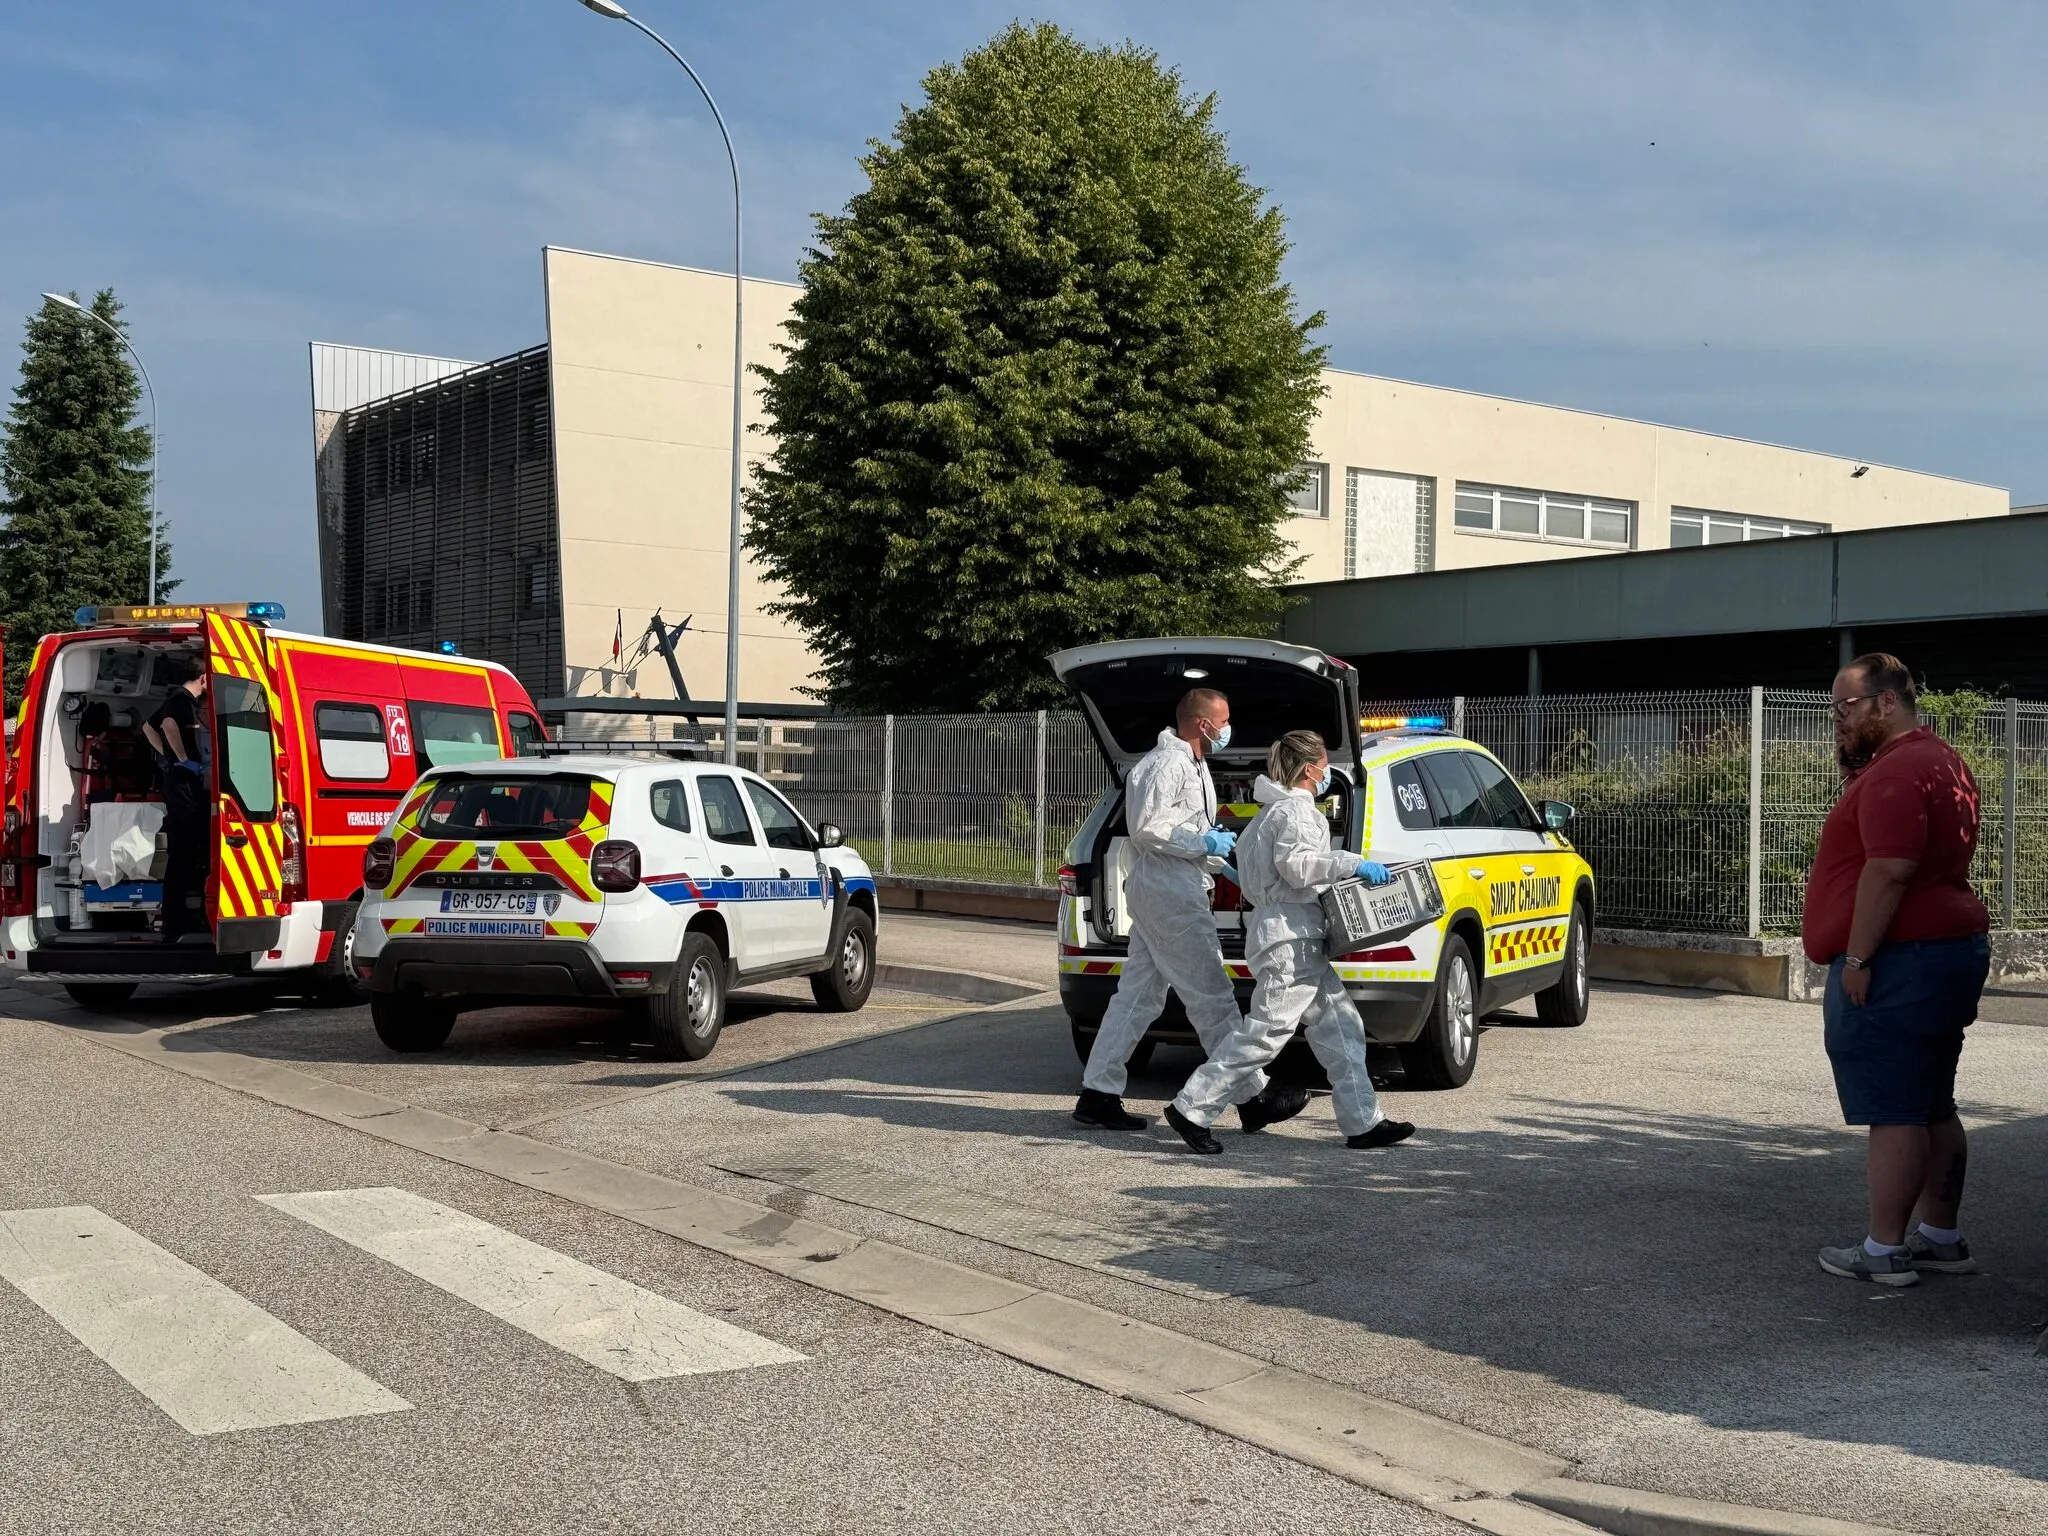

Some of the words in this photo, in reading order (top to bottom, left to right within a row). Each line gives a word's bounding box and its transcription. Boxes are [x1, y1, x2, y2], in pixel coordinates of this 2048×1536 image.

[395, 733, 408, 752] 18
[1408, 783, 1427, 810] 15
[436, 876, 533, 886] DUSTER
[744, 881, 769, 899] POLICE
[769, 880, 808, 898] MUNICIPALE
[452, 892, 526, 911] GR-057-CG
[1490, 880, 1516, 918] SMUR
[1519, 875, 1561, 913] CHAUMONT
[427, 921, 467, 934] POLICE
[469, 922, 541, 935] MUNICIPALE
